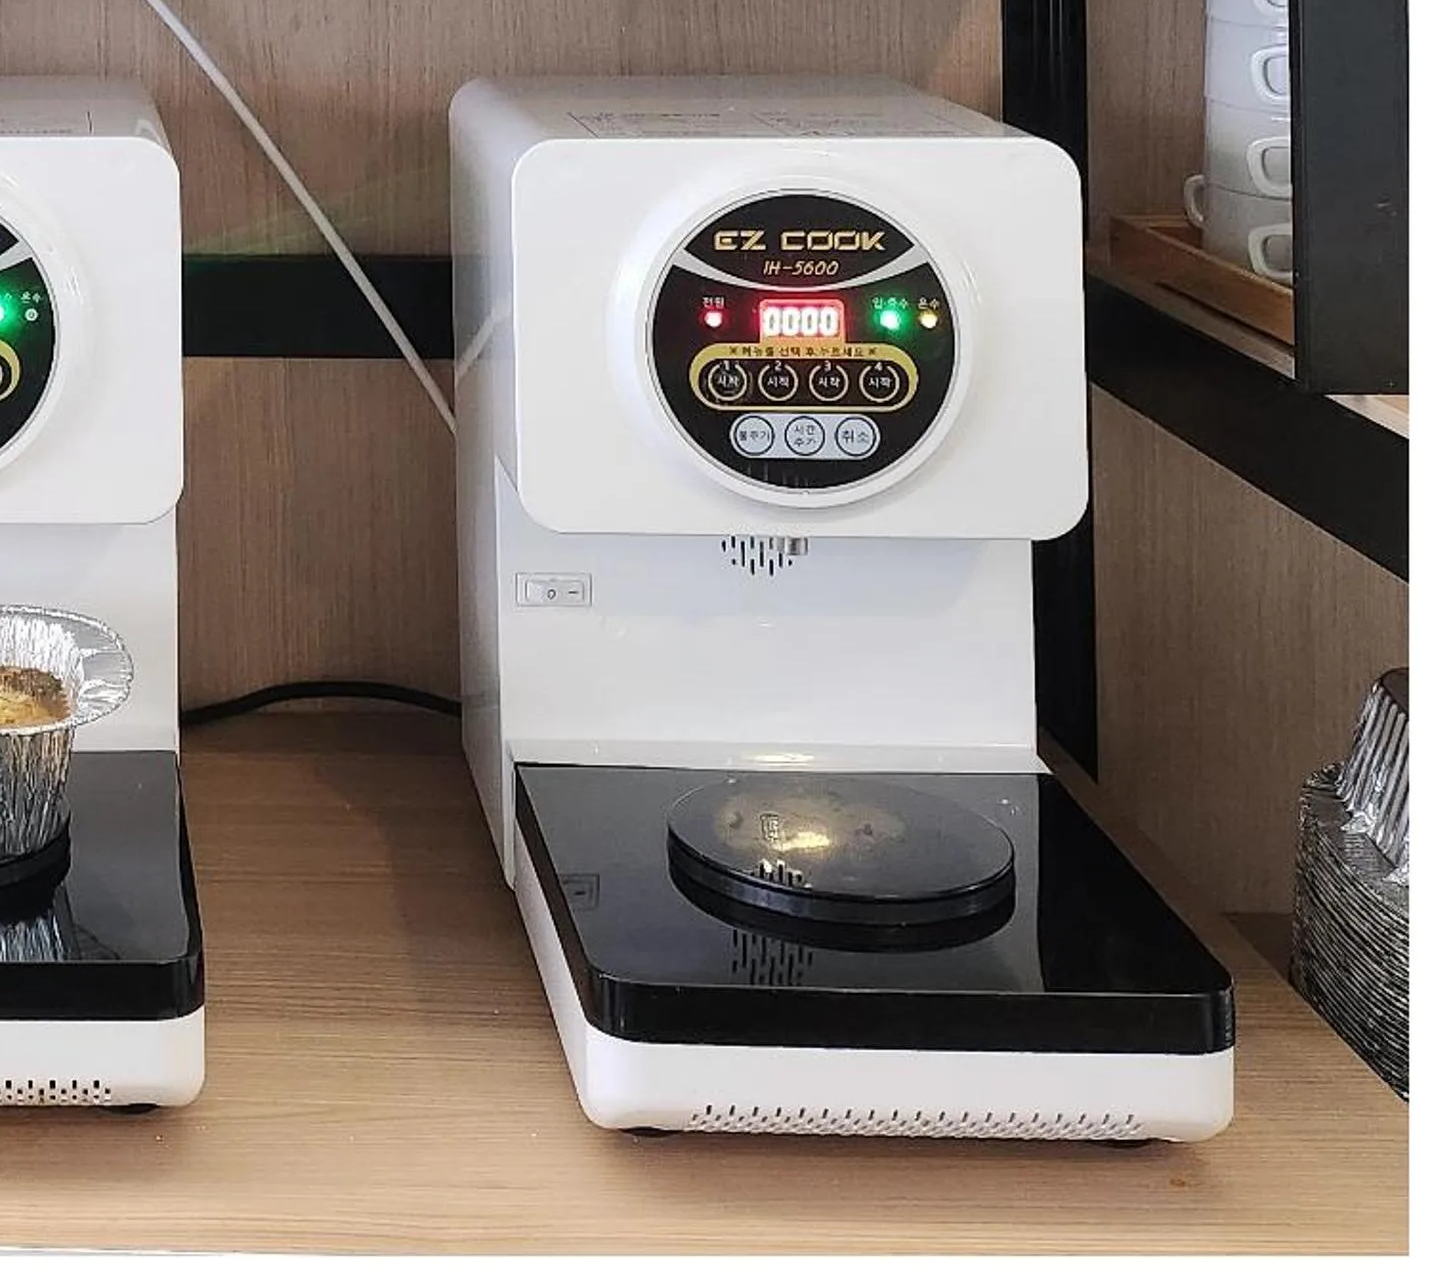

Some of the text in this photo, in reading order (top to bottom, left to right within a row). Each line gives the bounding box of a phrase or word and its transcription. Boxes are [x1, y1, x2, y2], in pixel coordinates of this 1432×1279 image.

[714, 230, 887, 251] EZ COOK
[763, 260, 839, 276] IH-5600
[763, 306, 838, 337] 0000
